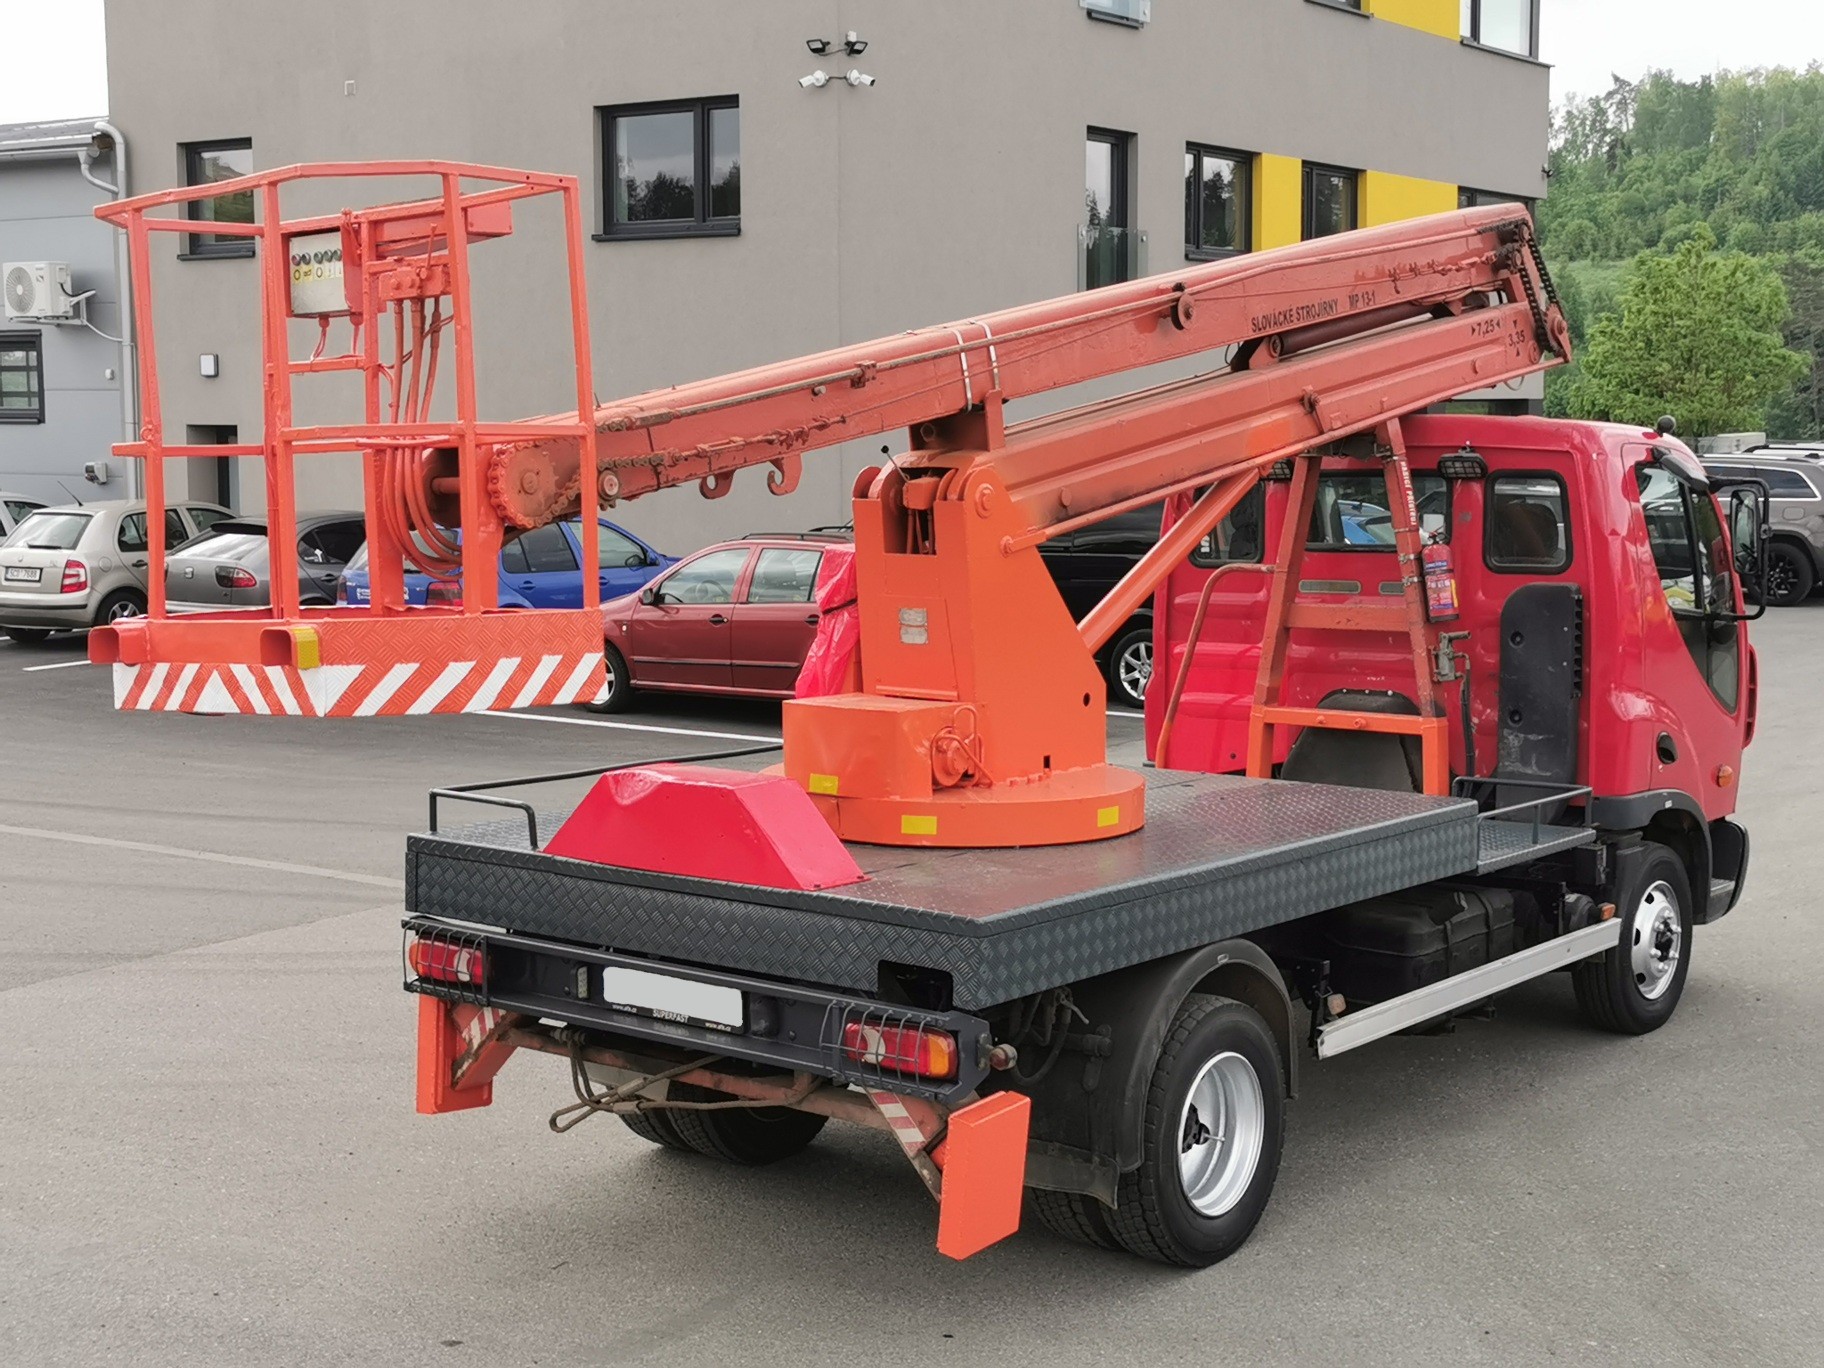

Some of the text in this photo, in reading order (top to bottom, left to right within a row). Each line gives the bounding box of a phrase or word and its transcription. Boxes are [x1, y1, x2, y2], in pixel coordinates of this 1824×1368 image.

[1251, 304, 1294, 333] SLOVÁCKÉ
[1296, 298, 1339, 321] STROJÍRNY
[1348, 294, 1359, 309] MP
[1508, 329, 1526, 349] 3,35
[652, 1008, 690, 1024] SUPERFAST
